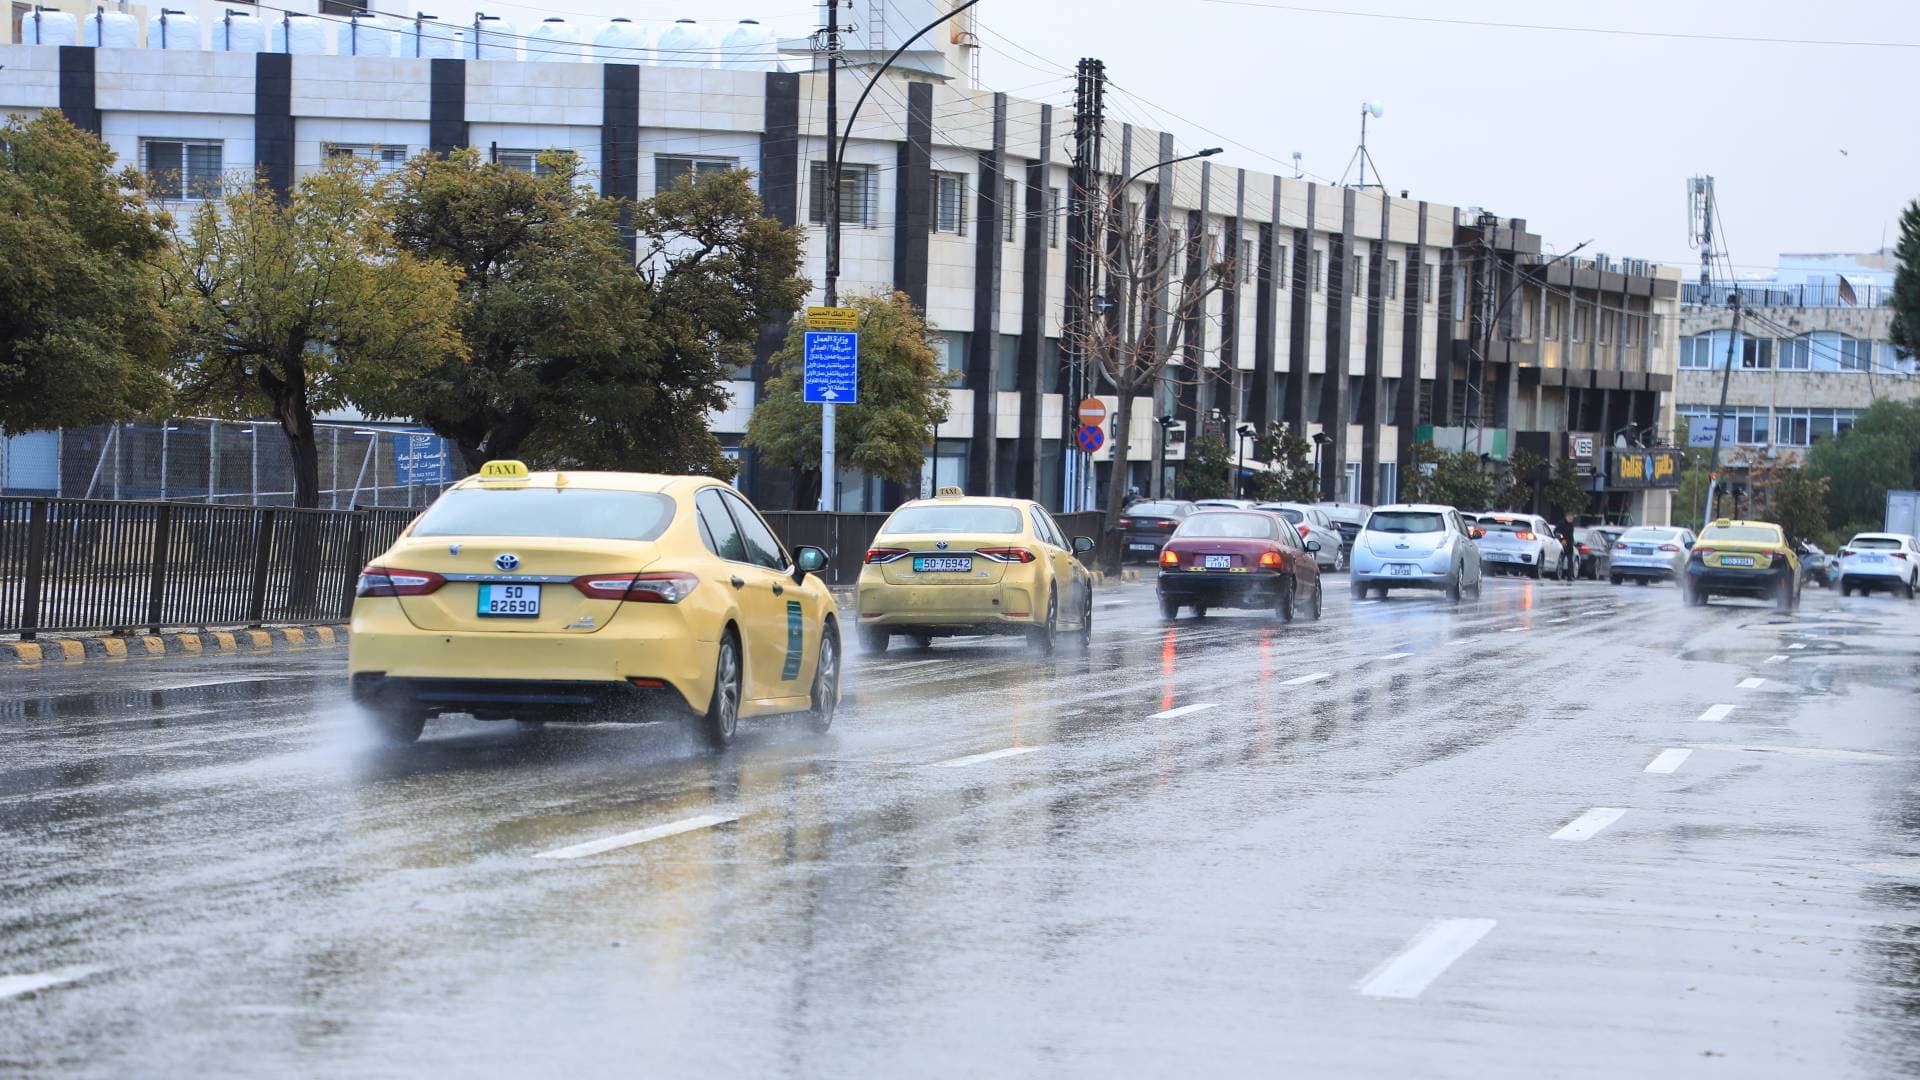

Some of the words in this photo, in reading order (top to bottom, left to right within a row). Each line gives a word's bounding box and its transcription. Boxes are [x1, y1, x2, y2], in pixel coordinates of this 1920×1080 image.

[814, 335, 832, 344] العمل
[487, 464, 516, 474] TAXI
[1621, 454, 1642, 478] Dallas
[505, 586, 523, 598] 50
[490, 600, 537, 612] 82690
